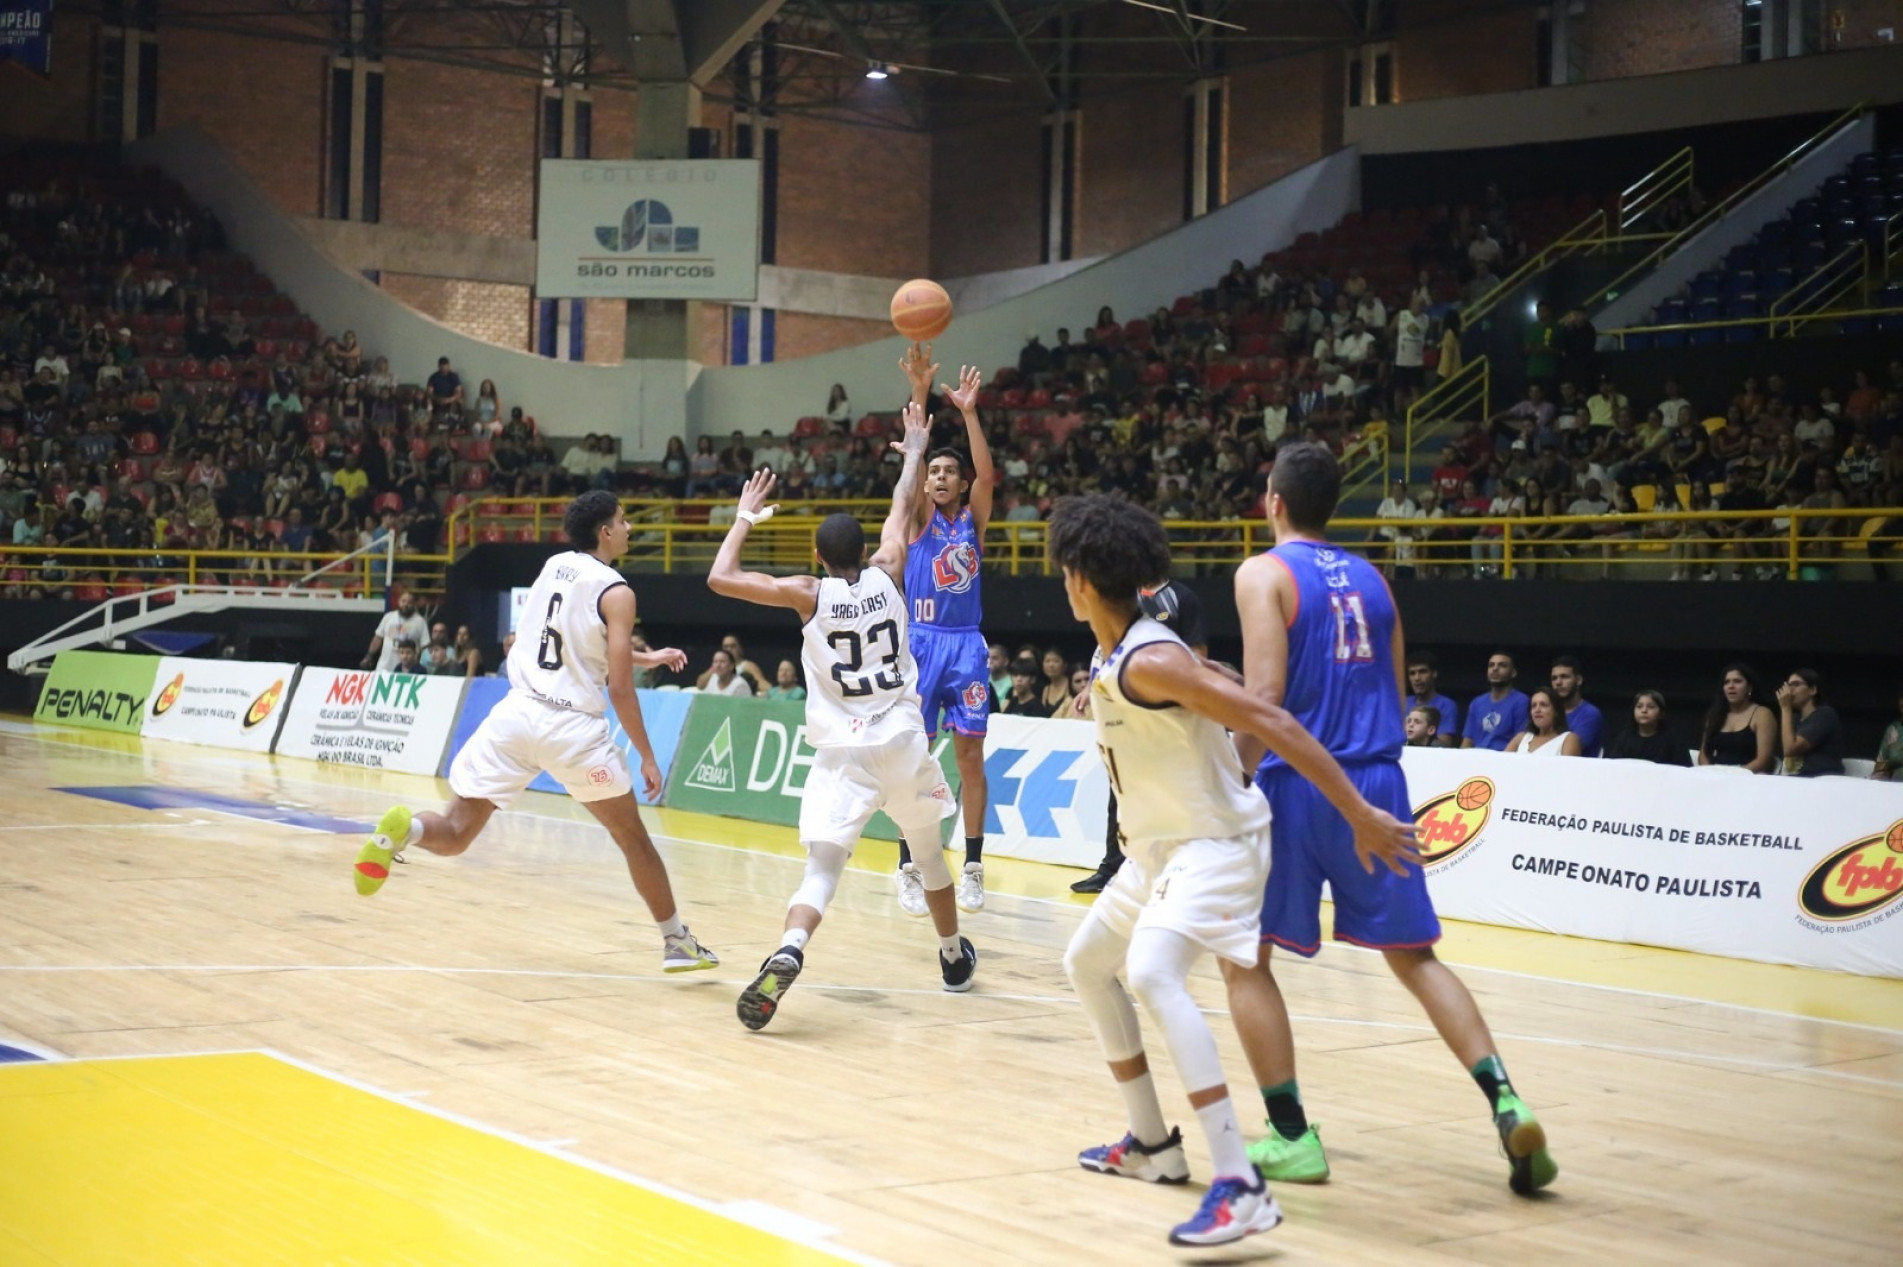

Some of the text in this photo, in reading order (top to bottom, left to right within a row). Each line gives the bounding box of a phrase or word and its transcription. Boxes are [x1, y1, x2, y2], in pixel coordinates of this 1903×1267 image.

[577, 262, 716, 278] são marcos
[914, 598, 935, 622] 00
[1329, 593, 1375, 662] 11
[537, 592, 564, 671] 6
[826, 618, 905, 697] 23
[40, 687, 145, 726] PENALTY
[325, 672, 371, 705] NGK
[371, 672, 427, 710] NTK
[697, 763, 730, 785] DEMAX
[1501, 807, 1804, 851] FEDERAÇÃO PAULISTA DE BASKETBALL
[1655, 875, 1762, 900] PAULISTA
